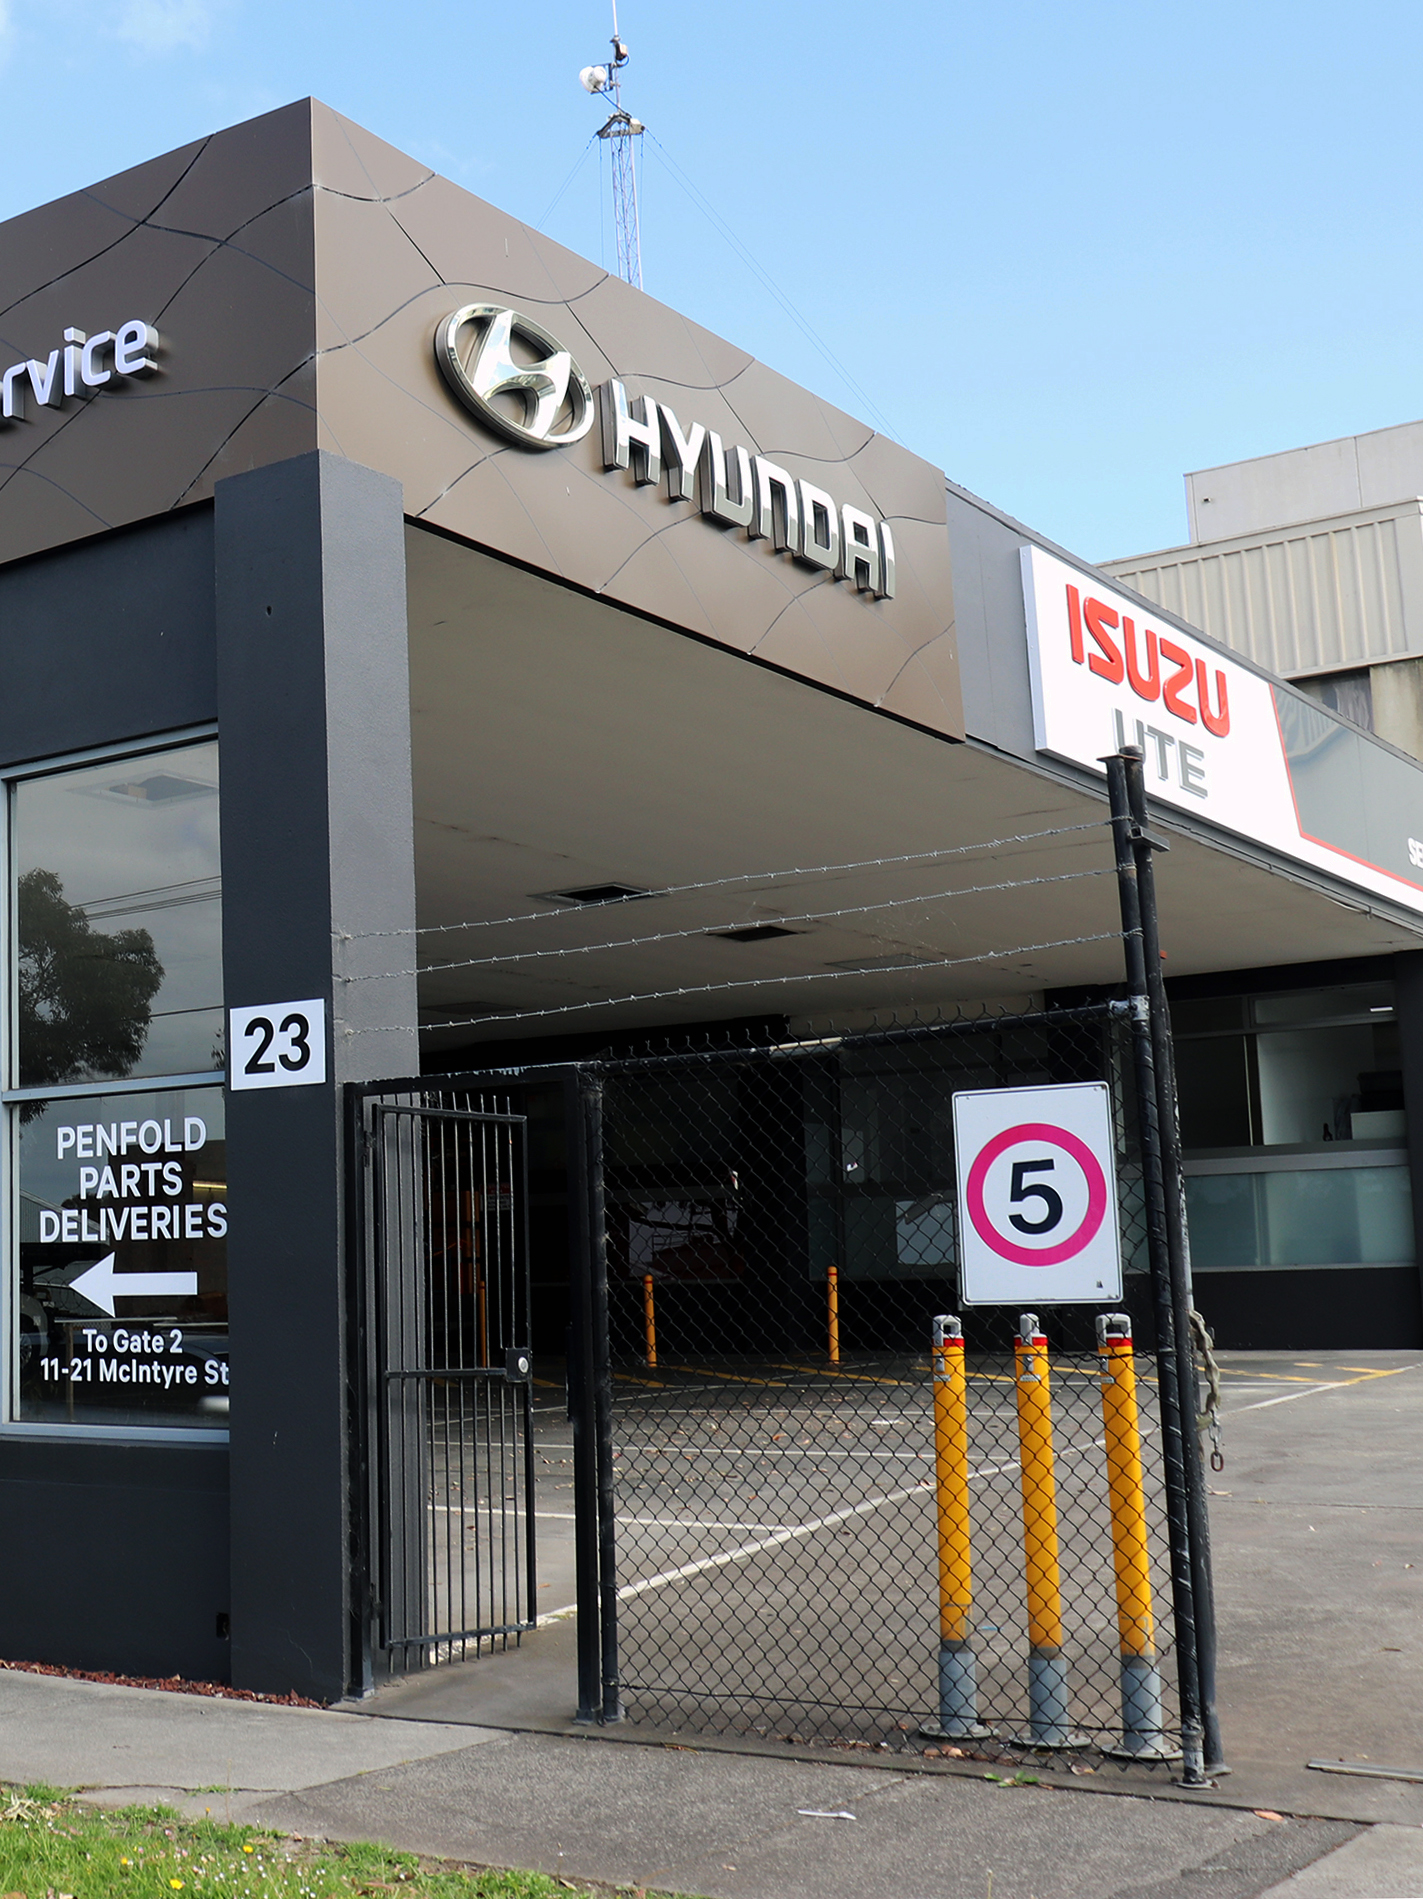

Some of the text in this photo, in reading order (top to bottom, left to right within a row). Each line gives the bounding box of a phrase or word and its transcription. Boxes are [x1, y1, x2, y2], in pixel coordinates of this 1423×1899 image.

[599, 377, 896, 600] HYUNDAI
[1066, 583, 1230, 738] ISUZU
[1113, 707, 1208, 798] UTE
[244, 1013, 311, 1075] 23
[57, 1117, 207, 1160] PENFOLD
[80, 1161, 183, 1200] PARTS
[1007, 1159, 1063, 1235] 5
[40, 1203, 228, 1243] DELIVERIES
[83, 1329, 183, 1354] To Gate 2
[40, 1358, 229, 1390] 11-21 McIntyre St
